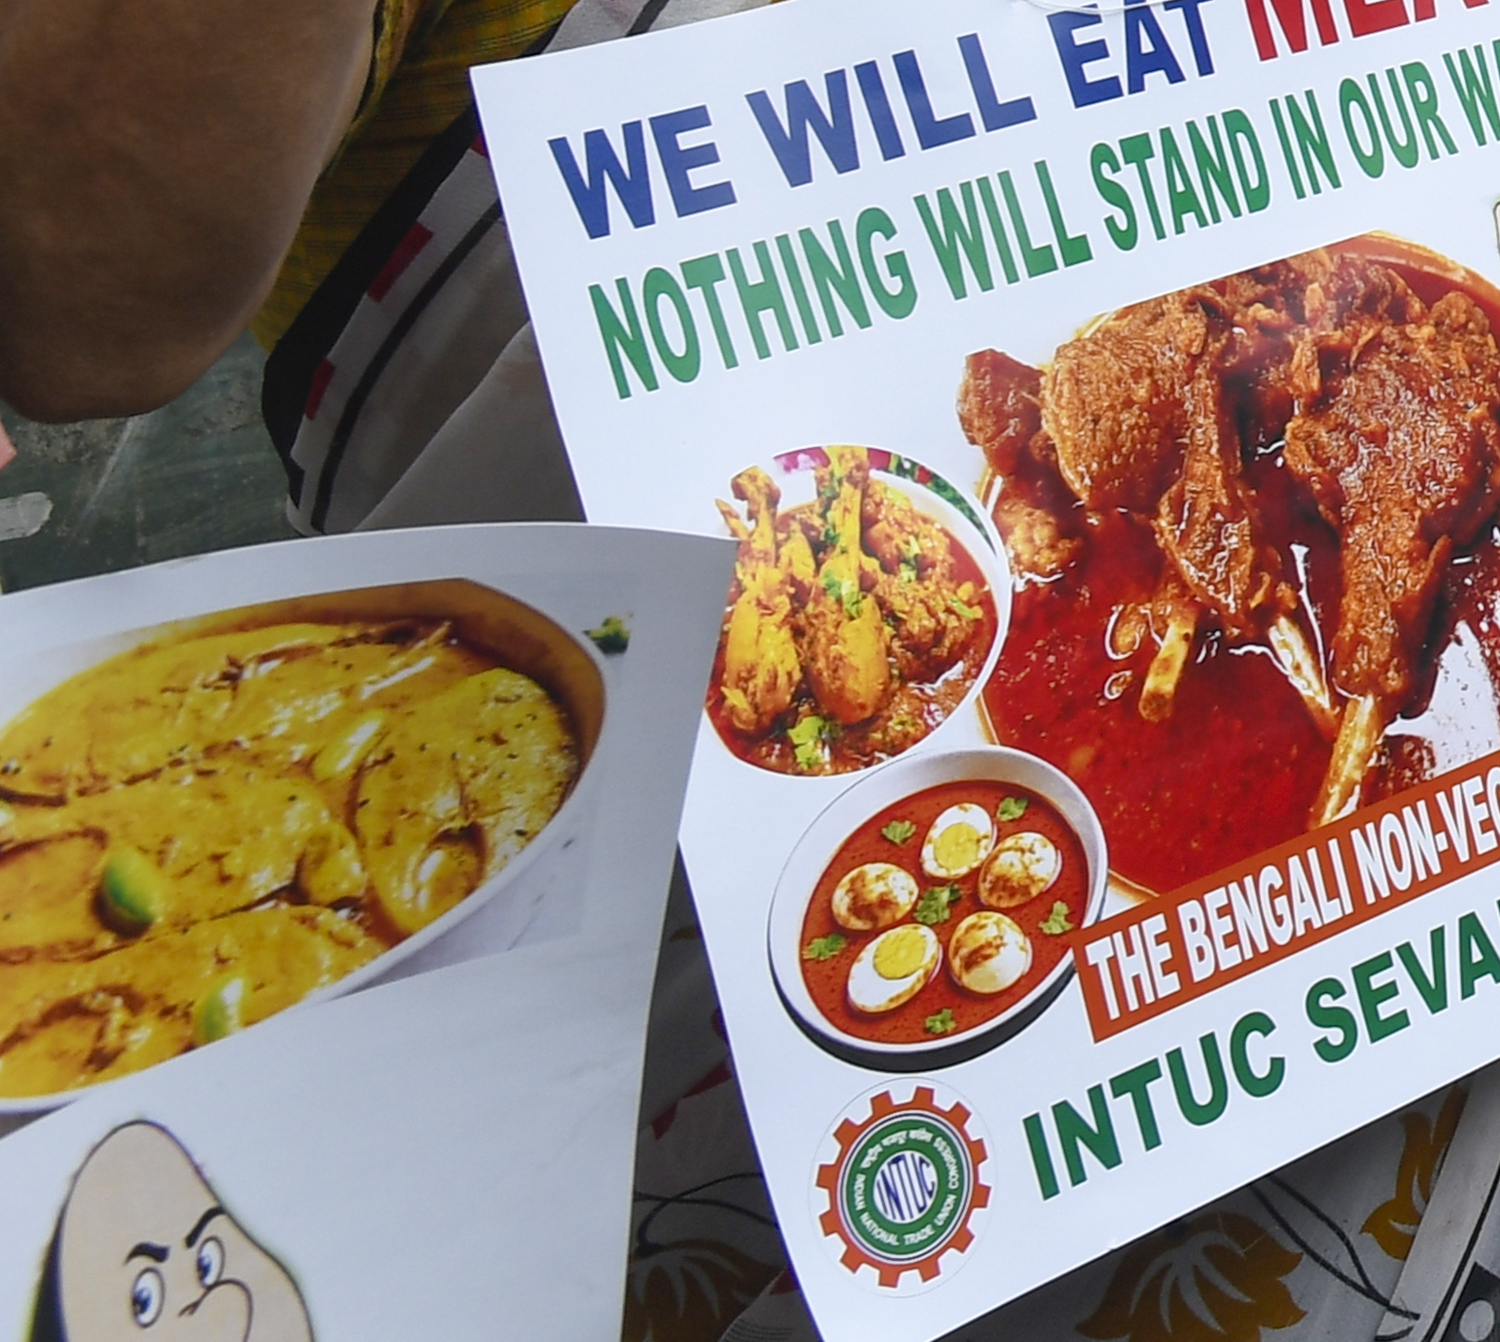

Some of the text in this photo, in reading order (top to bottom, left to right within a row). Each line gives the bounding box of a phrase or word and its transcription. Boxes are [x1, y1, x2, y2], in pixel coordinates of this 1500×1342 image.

[547, 104, 738, 240] WE
[744, 32, 1038, 188] WILL
[588, 206, 918, 401] NOTHING
[913, 159, 1094, 302] WILL
[1089, 108, 1272, 252] STAND
[1268, 90, 1343, 200] IN
[1338, 62, 1459, 179] OUR
[1084, 912, 1182, 1021] THE
[1177, 837, 1355, 984] BENGALI
[1022, 1011, 1286, 1201] INTUC
[876, 1152, 936, 1222] INTUC
[933, 1137, 960, 1190] CONGRESS
[859, 1212, 900, 1246] NATIONAL
[903, 1224, 935, 1246] TRADE
[934, 1194, 957, 1226] UNION
